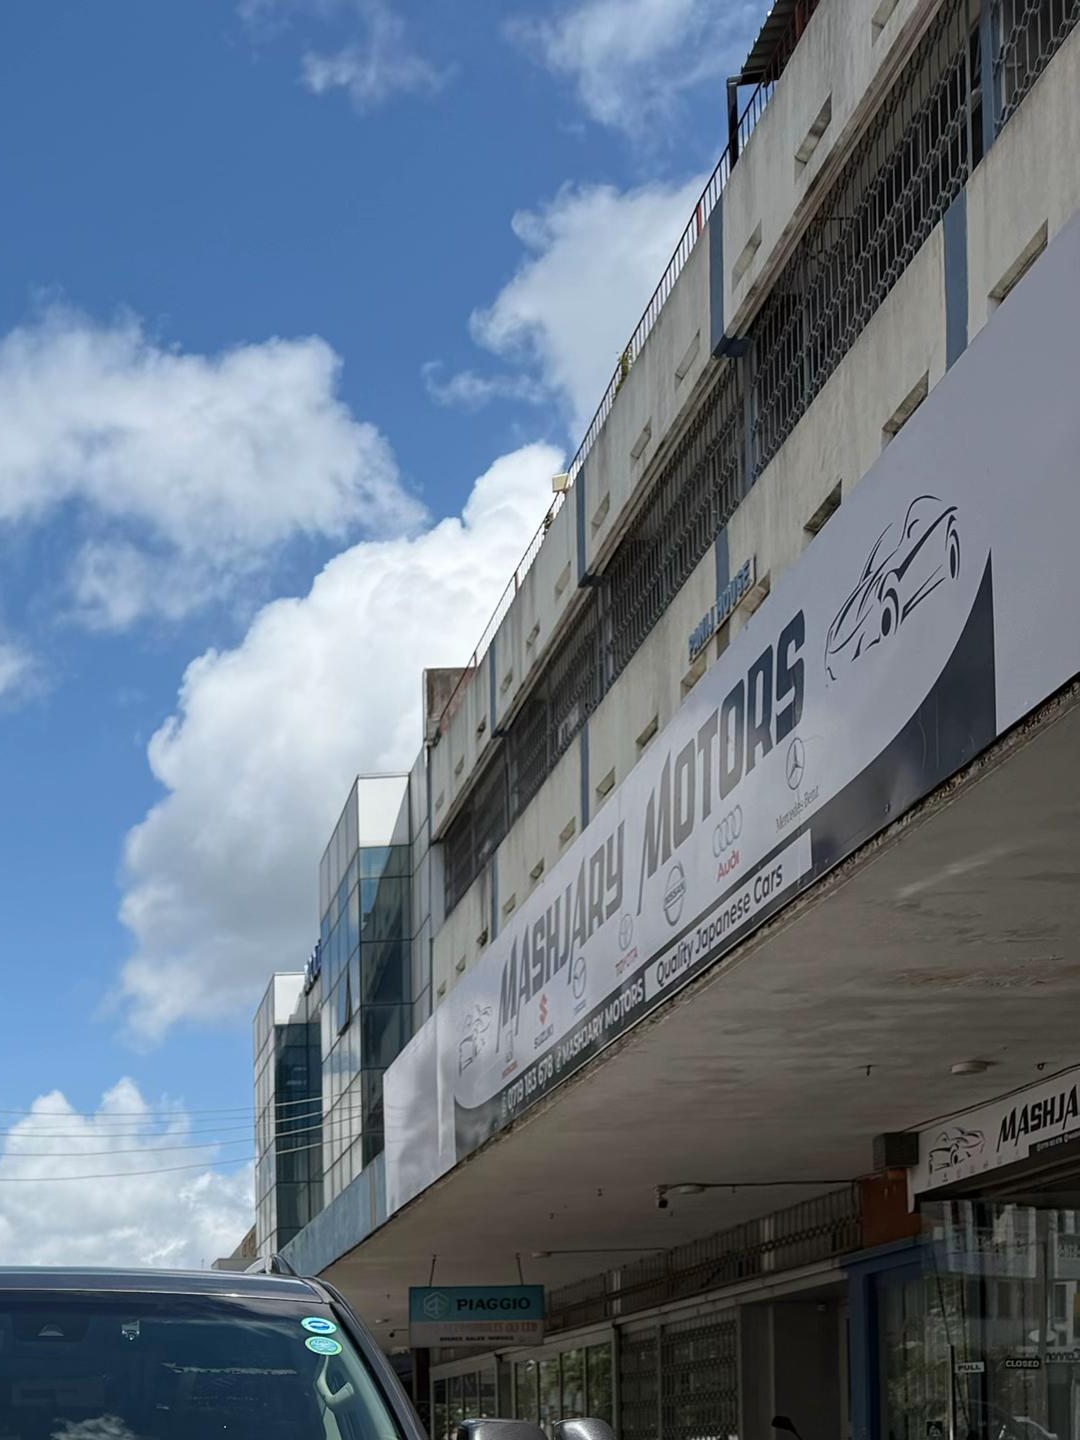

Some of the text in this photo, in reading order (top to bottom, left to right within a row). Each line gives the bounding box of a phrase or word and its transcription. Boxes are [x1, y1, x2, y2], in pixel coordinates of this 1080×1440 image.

[775, 784, 819, 833] Mercedes-Benz
[497, 608, 805, 1054] MASHJARY MOTORS
[716, 849, 740, 881] Audi
[656, 864, 783, 987] Quality Japanese Cars
[604, 977, 644, 1029] MOTORS
[456, 1296, 531, 1311] PIAGGIO
[958, 1362, 980, 1371] PULL
[1005, 1360, 1040, 1368] CLOSED
